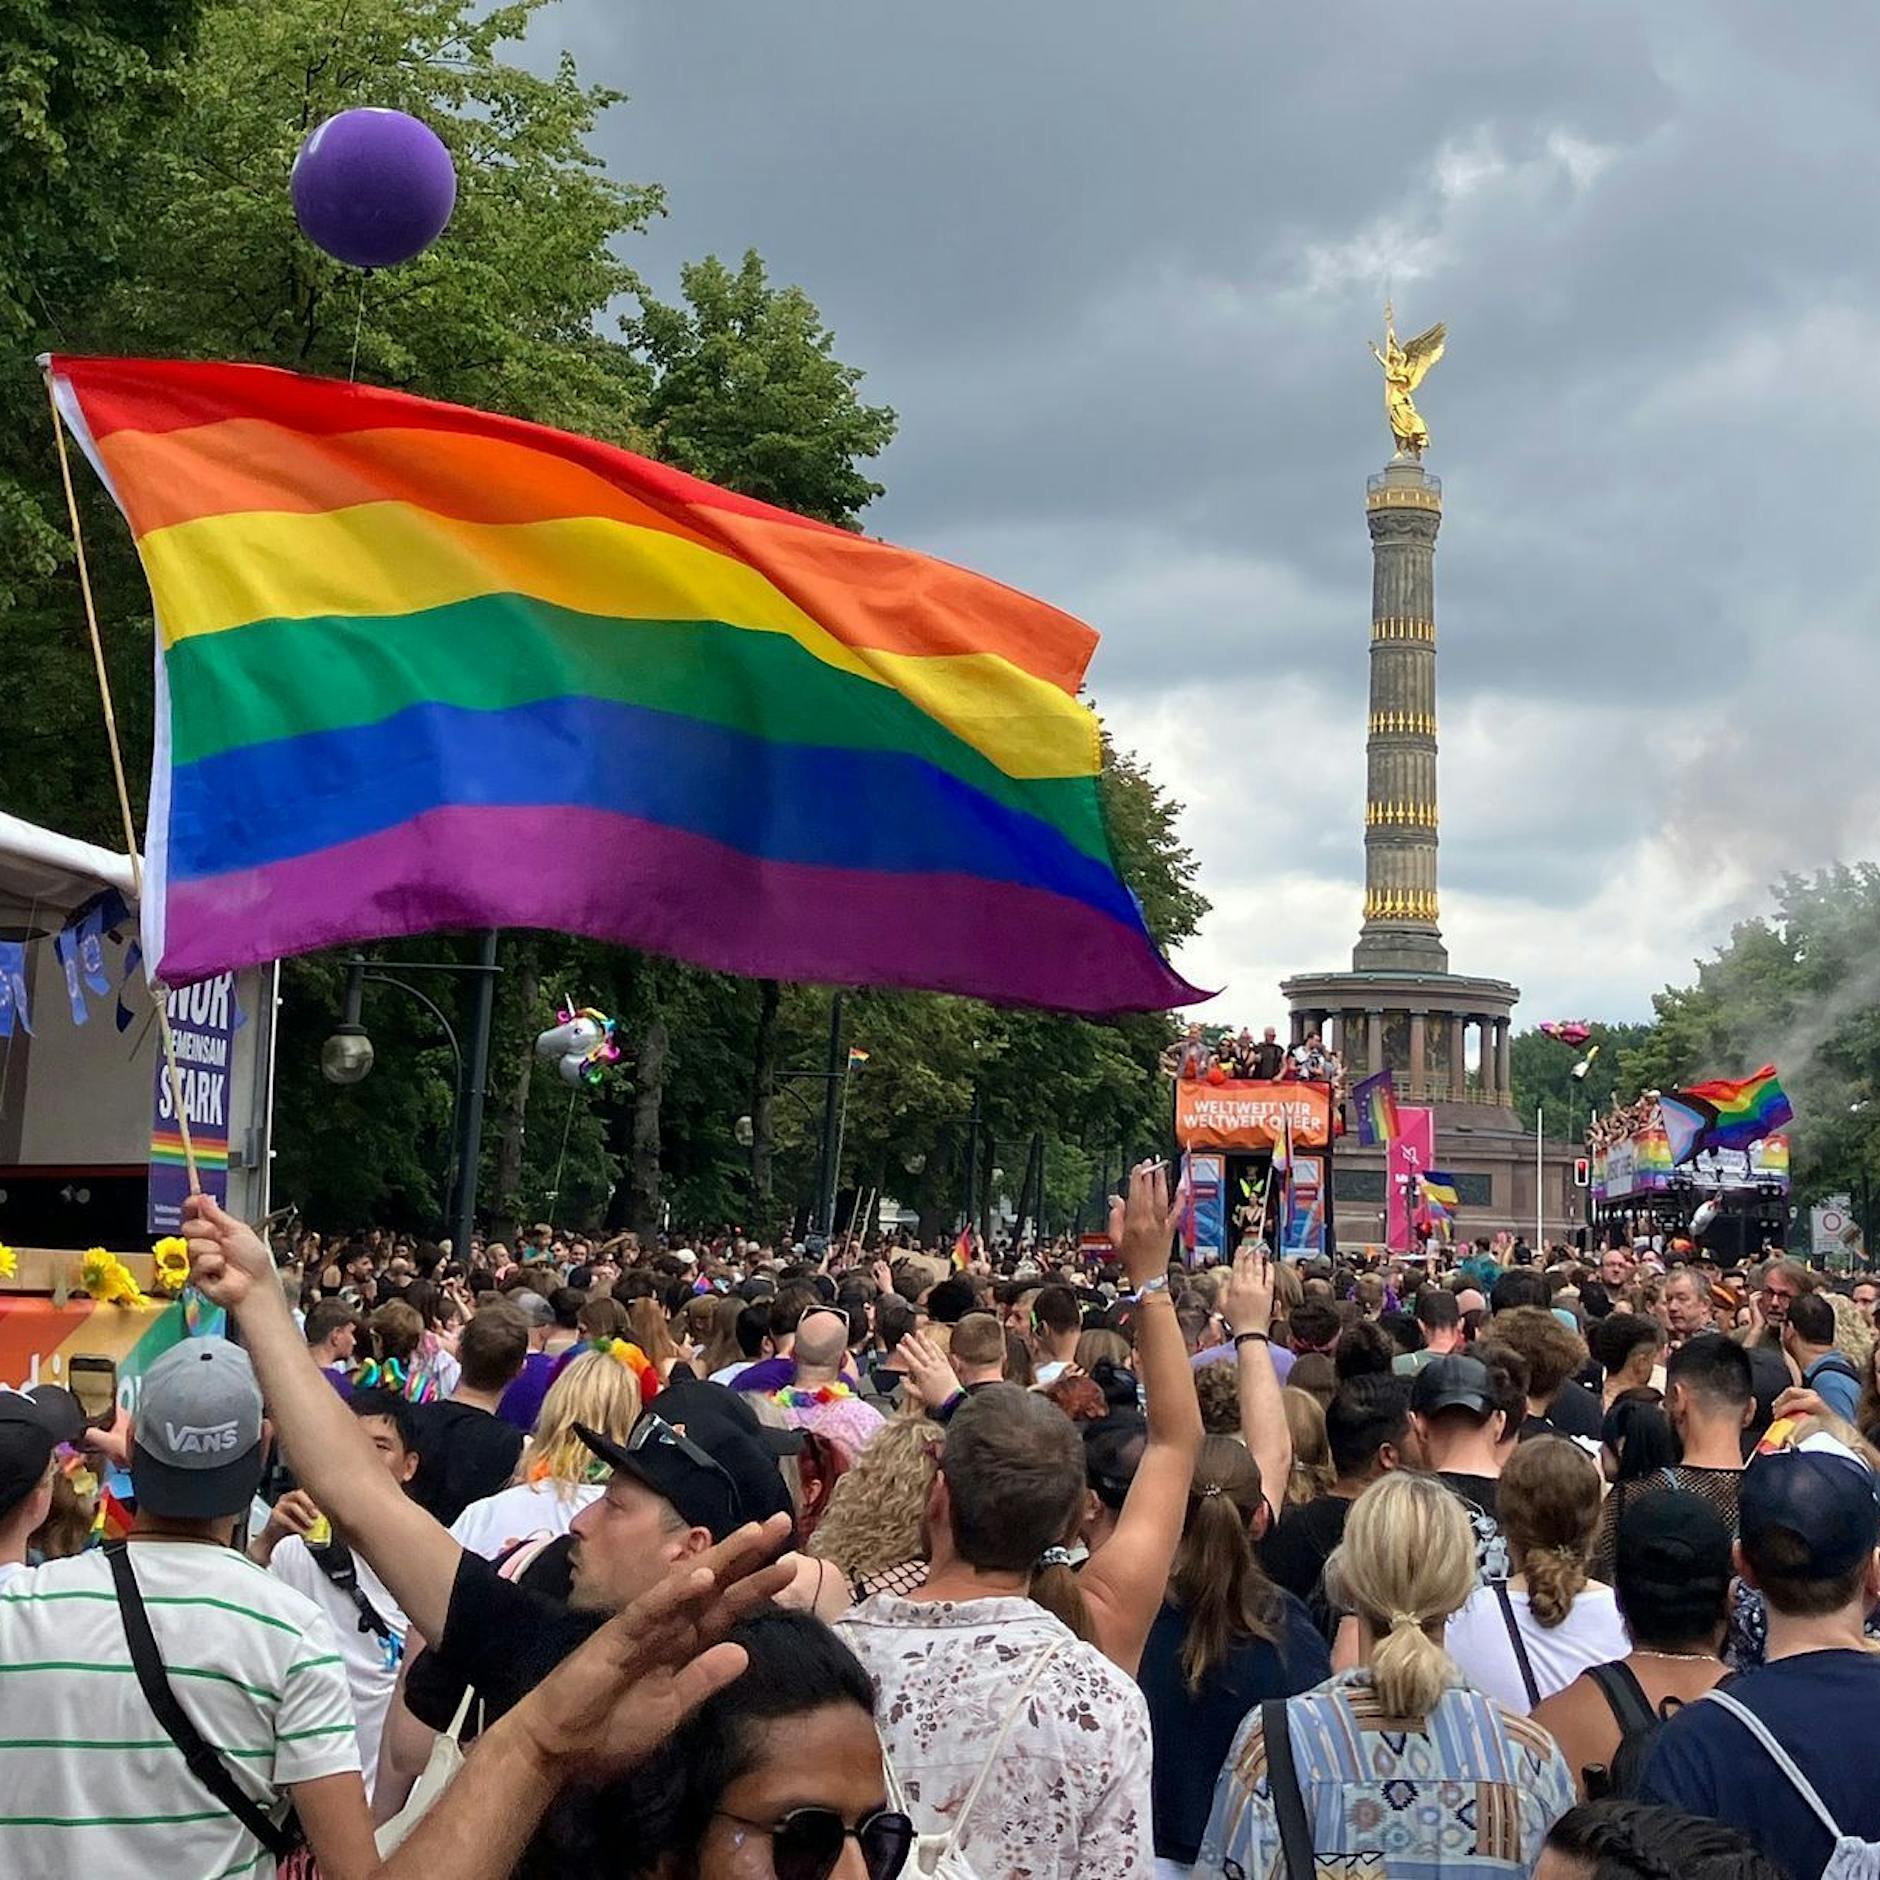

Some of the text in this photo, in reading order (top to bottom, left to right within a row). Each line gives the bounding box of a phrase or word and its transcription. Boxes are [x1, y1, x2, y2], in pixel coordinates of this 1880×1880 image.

[163, 1029, 227, 1067] EMEINSAM
[159, 1065, 226, 1126] STARK
[1194, 1100, 1312, 1116] WELTWEIT WIR
[1183, 1114, 1265, 1130] WELTWEIT
[165, 1420, 240, 1454] VANS
